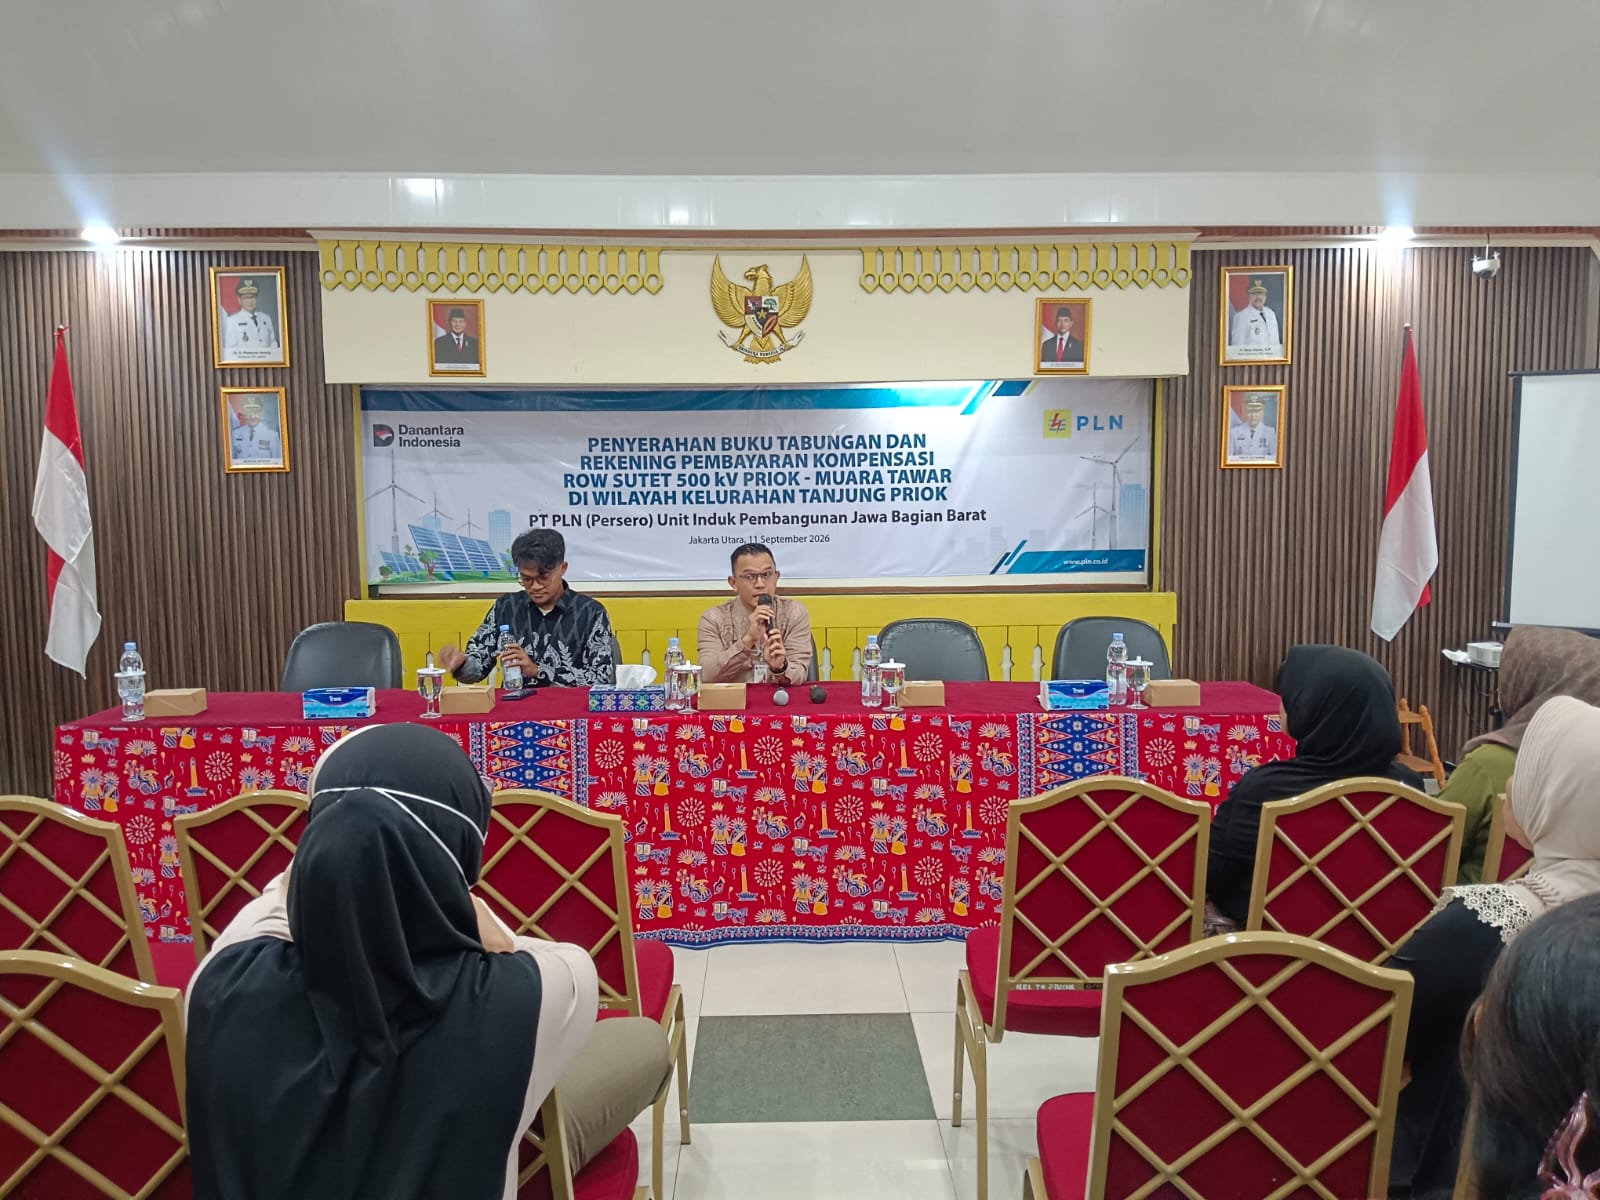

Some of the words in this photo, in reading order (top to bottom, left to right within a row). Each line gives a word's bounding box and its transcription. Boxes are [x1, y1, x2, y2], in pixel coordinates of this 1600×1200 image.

[399, 424, 464, 435] Danantara
[1077, 415, 1123, 431] PLN
[399, 437, 461, 447] Indonesia
[588, 437, 716, 452] PENYERAHAN
[721, 436, 773, 450] BUKU
[777, 434, 881, 450] TABUNGAN
[886, 433, 926, 449] DAN
[580, 455, 676, 470] REKENING
[681, 453, 808, 469] PEMBAYARAN
[813, 451, 934, 468] KOMPENSASI
[563, 473, 608, 488] ROW
[613, 473, 672, 488] SUTET
[676, 473, 710, 487] 500
[714, 471, 738, 487] kV
[743, 471, 800, 487] PRIOK
[815, 470, 884, 486] MUARA
[887, 468, 952, 484] TAWAR
[568, 491, 589, 506] DI
[592, 490, 677, 506] WILAYAH
[682, 489, 795, 505] KELURAHAN
[799, 487, 886, 503] TANJUNG
[890, 486, 948, 502] PRIOK
[529, 515, 547, 527] PT
[552, 514, 582, 527] PLN
[586, 513, 653, 528] (Persero)
[657, 513, 690, 526] Unit
[693, 512, 737, 526] Induk
[739, 511, 848, 528] Pembangunan
[851, 511, 888, 524] Jawa
[891, 509, 943, 525] Bagian
[946, 509, 987, 522] Barat
[688, 535, 718, 545] Jakarta
[721, 535, 746, 545] Utara,
[749, 535, 758, 544] 11
[760, 535, 807, 545] September
[809, 535, 830, 543] 2026
[1063, 557, 1109, 566] www.pln.co.id
